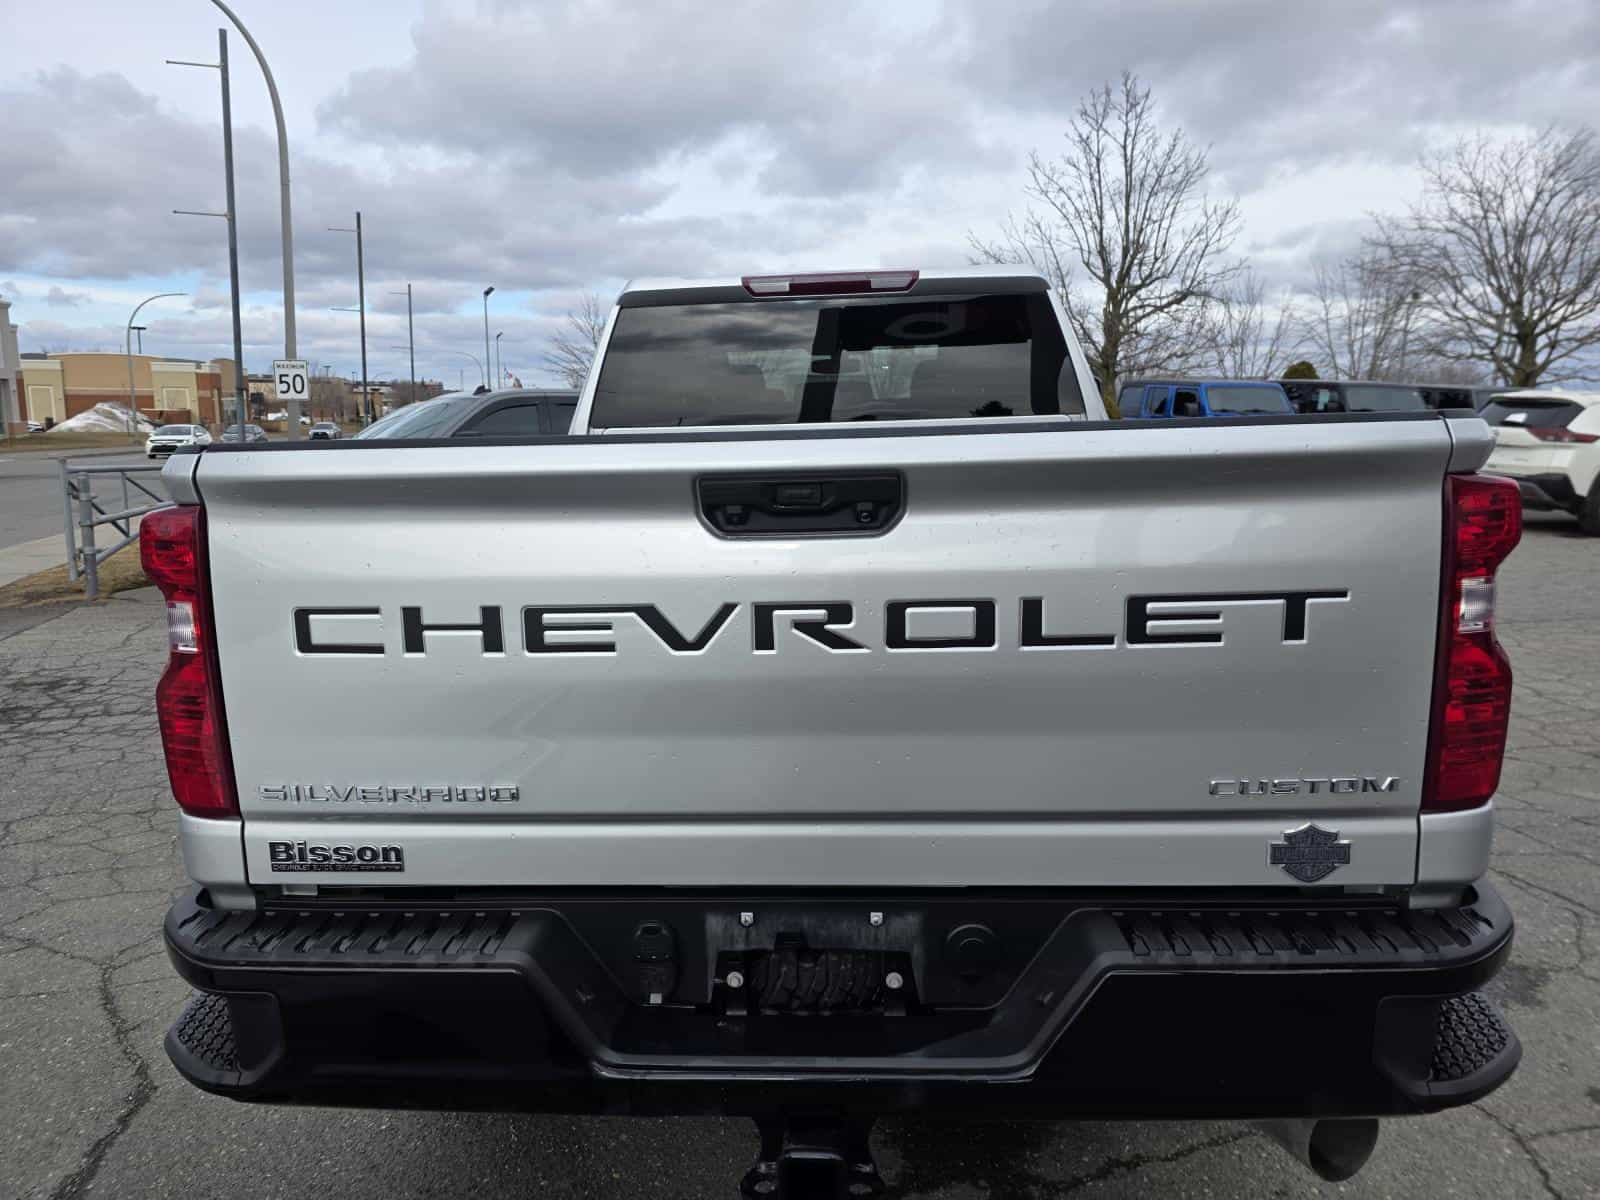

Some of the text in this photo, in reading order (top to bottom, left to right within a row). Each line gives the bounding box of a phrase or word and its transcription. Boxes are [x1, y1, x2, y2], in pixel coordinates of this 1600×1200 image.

[279, 374, 305, 394] 50
[293, 588, 1351, 657] CHEVROLET
[258, 784, 520, 802] SILVERADO
[1208, 776, 1401, 796] CUSTOM
[268, 840, 404, 863] Bisson
